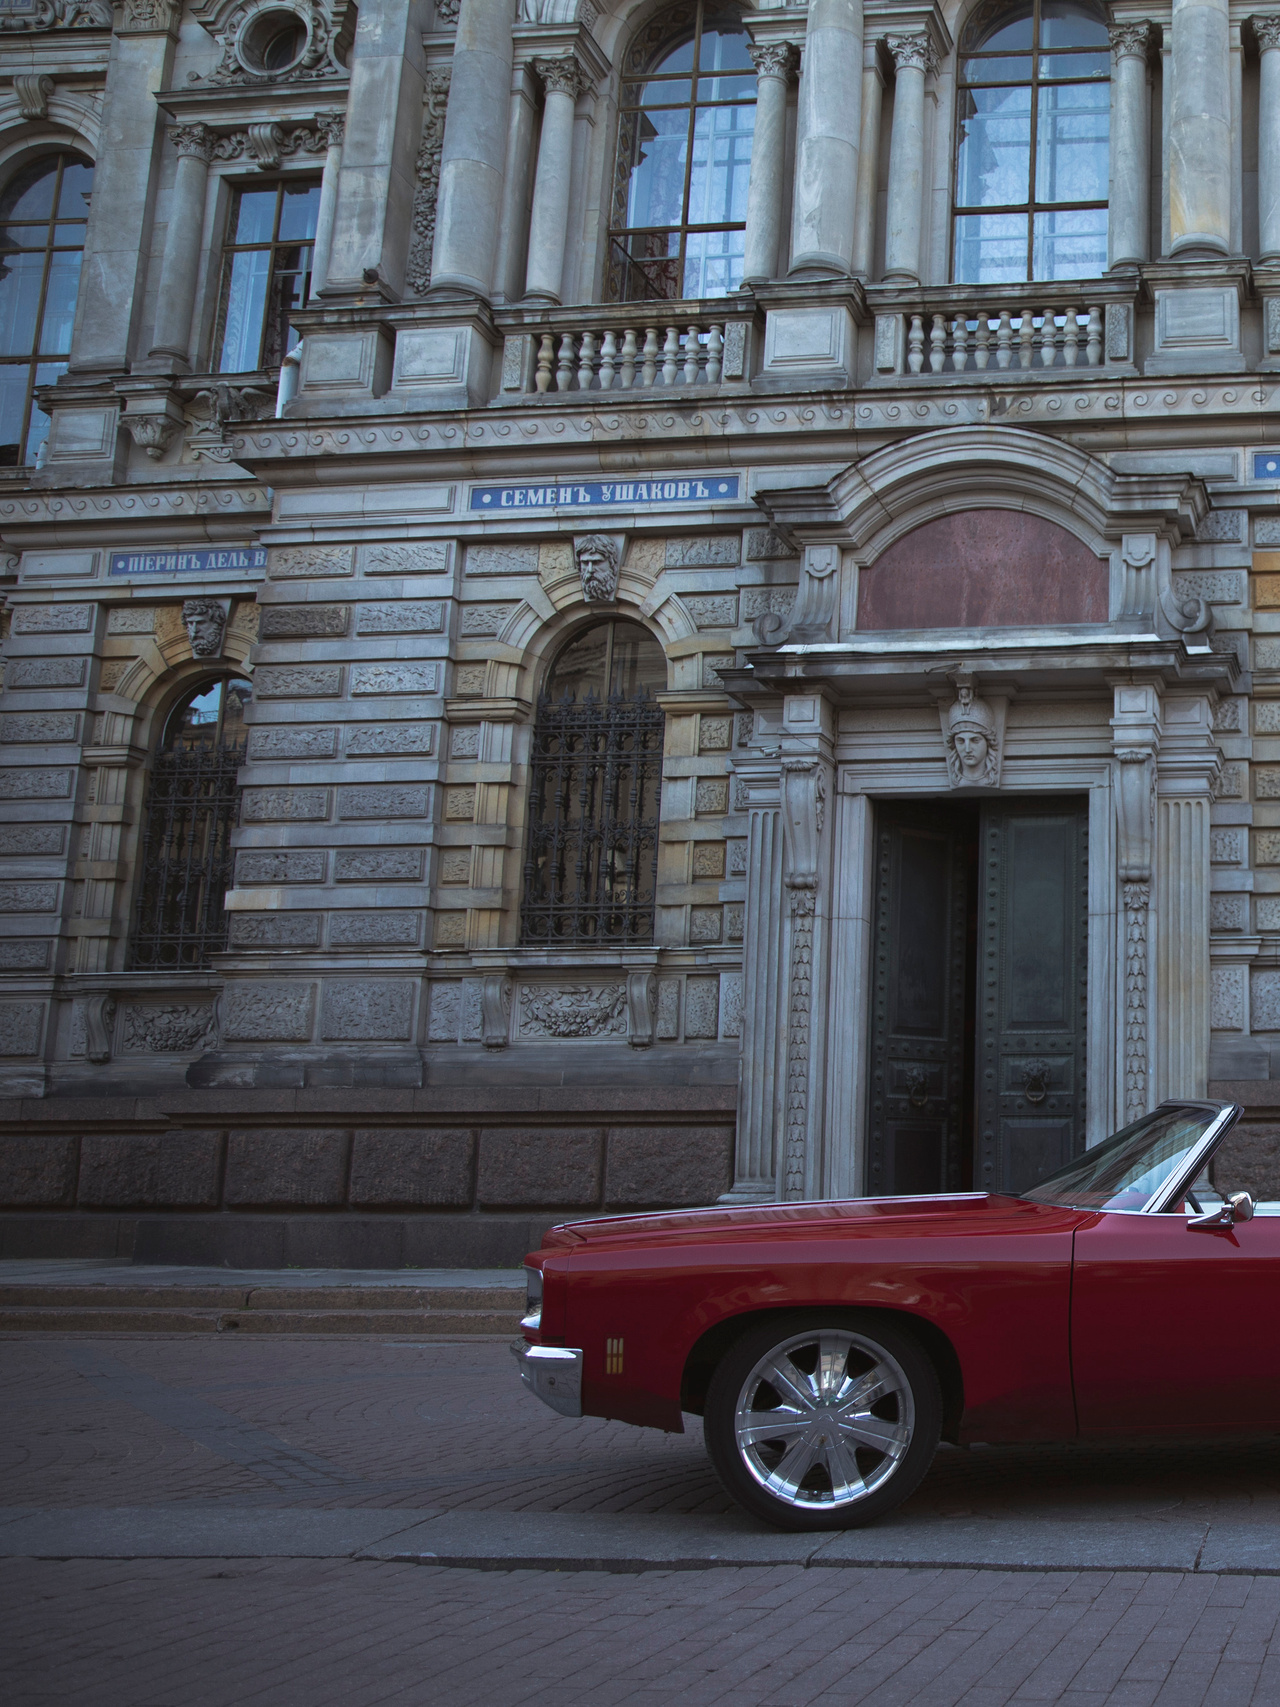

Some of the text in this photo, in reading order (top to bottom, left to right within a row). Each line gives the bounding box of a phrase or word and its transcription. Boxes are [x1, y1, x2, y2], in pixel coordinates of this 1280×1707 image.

[501, 481, 709, 506] СЕМЕНЪ УШАКОВЪ
[205, 552, 248, 569] ДЕЛЬ
